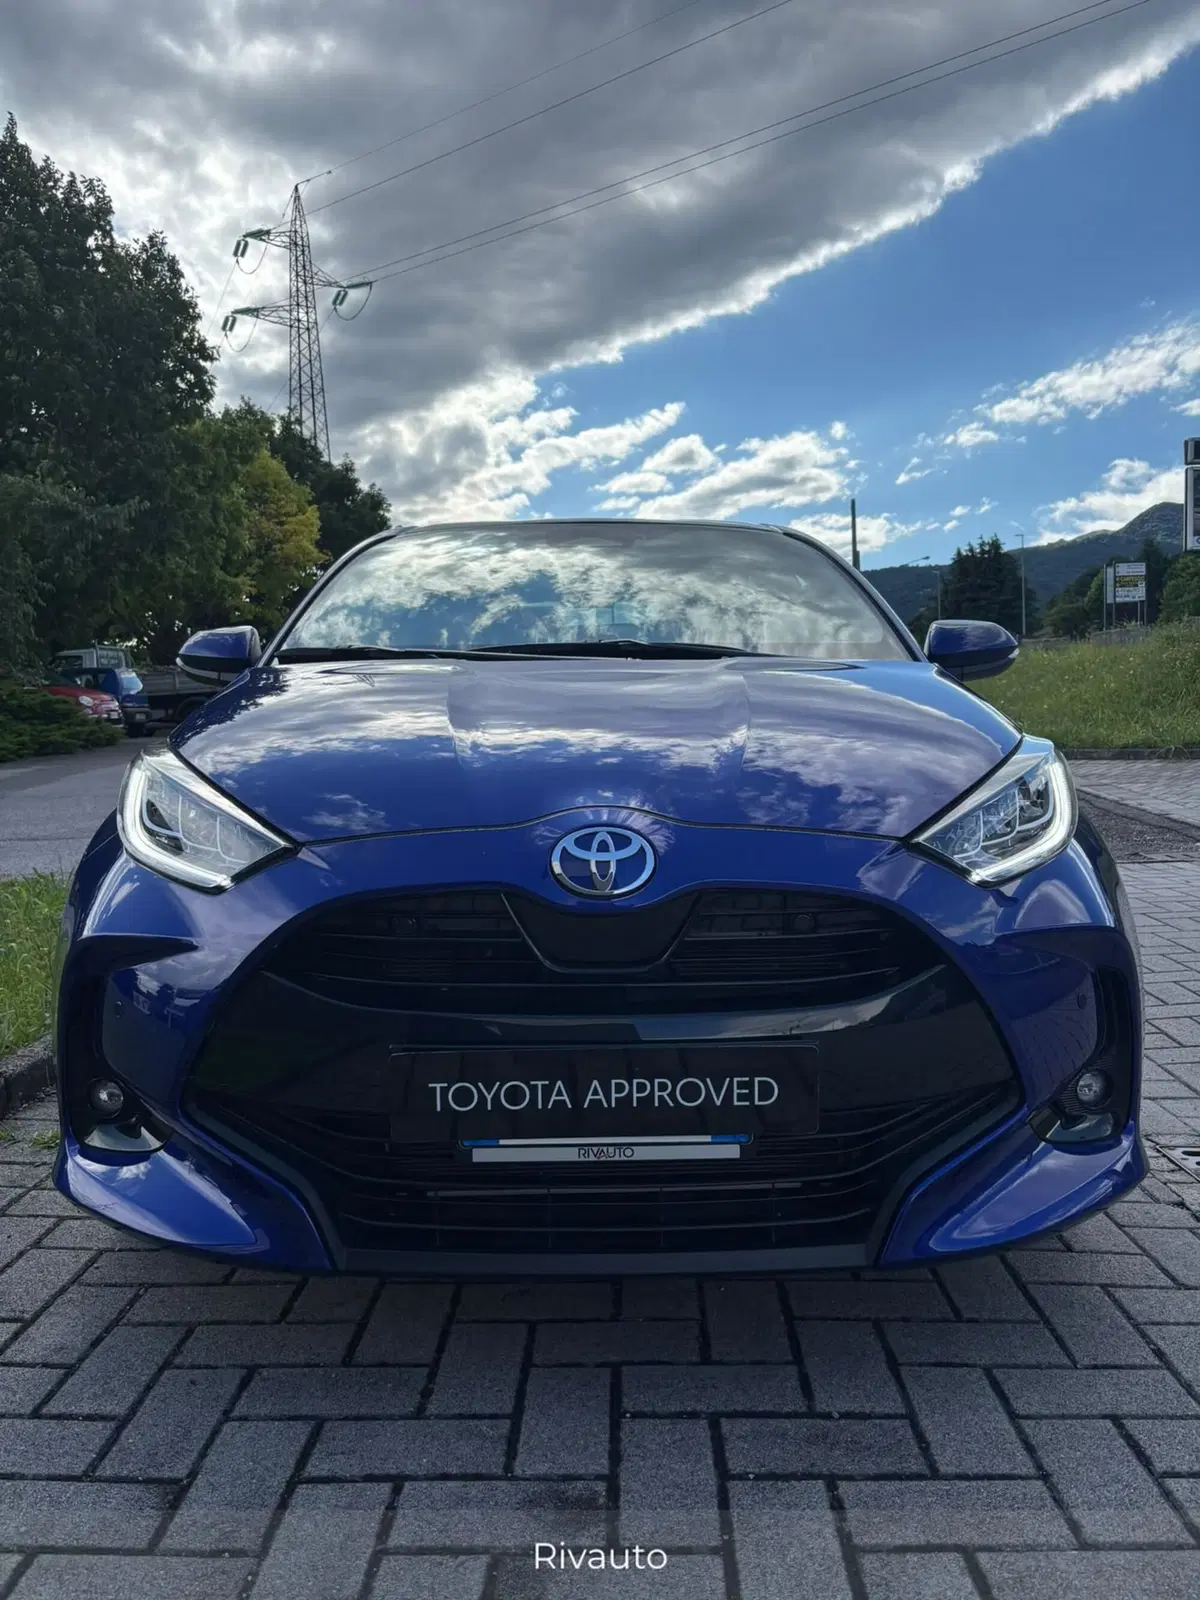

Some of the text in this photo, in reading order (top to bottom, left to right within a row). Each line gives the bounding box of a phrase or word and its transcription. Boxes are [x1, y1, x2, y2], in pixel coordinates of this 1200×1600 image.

[429, 1076, 779, 1112] TOYOTA APPROVED
[577, 1147, 635, 1160] RIVAUTO
